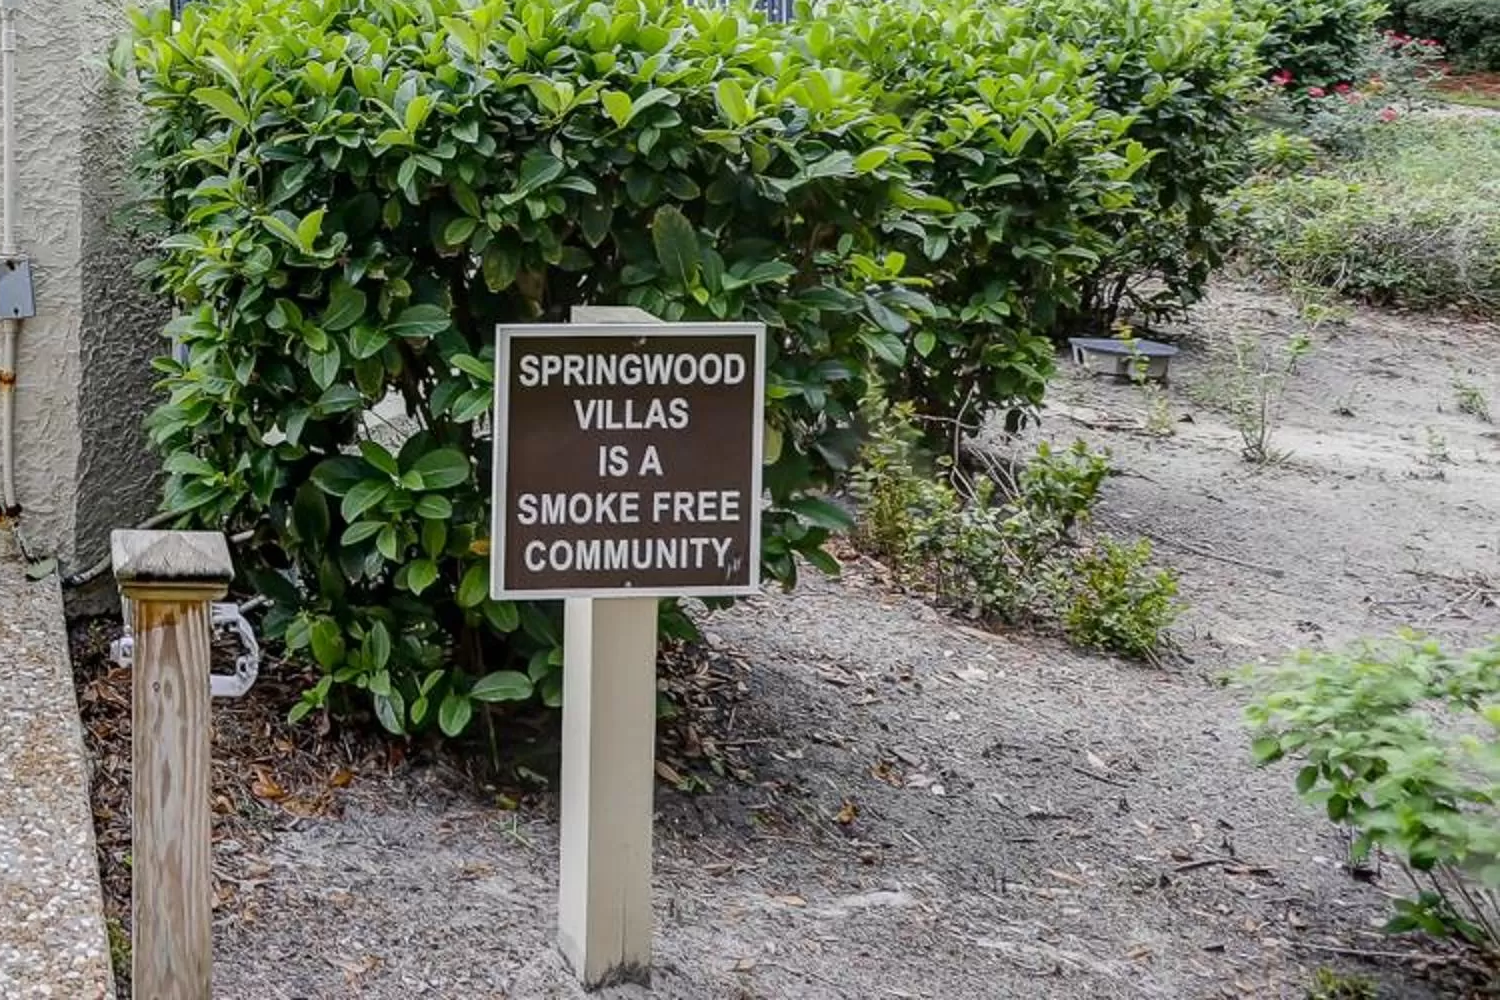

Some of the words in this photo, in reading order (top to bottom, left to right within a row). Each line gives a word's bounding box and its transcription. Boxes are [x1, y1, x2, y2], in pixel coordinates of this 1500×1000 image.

[519, 353, 746, 387] SPRINGWOOD
[574, 397, 689, 430] VILLAS
[599, 445, 629, 477] IS
[638, 445, 664, 477] A
[517, 491, 640, 525] SMOKE
[653, 490, 741, 523] FREE
[524, 537, 732, 572] COMMUNITY
